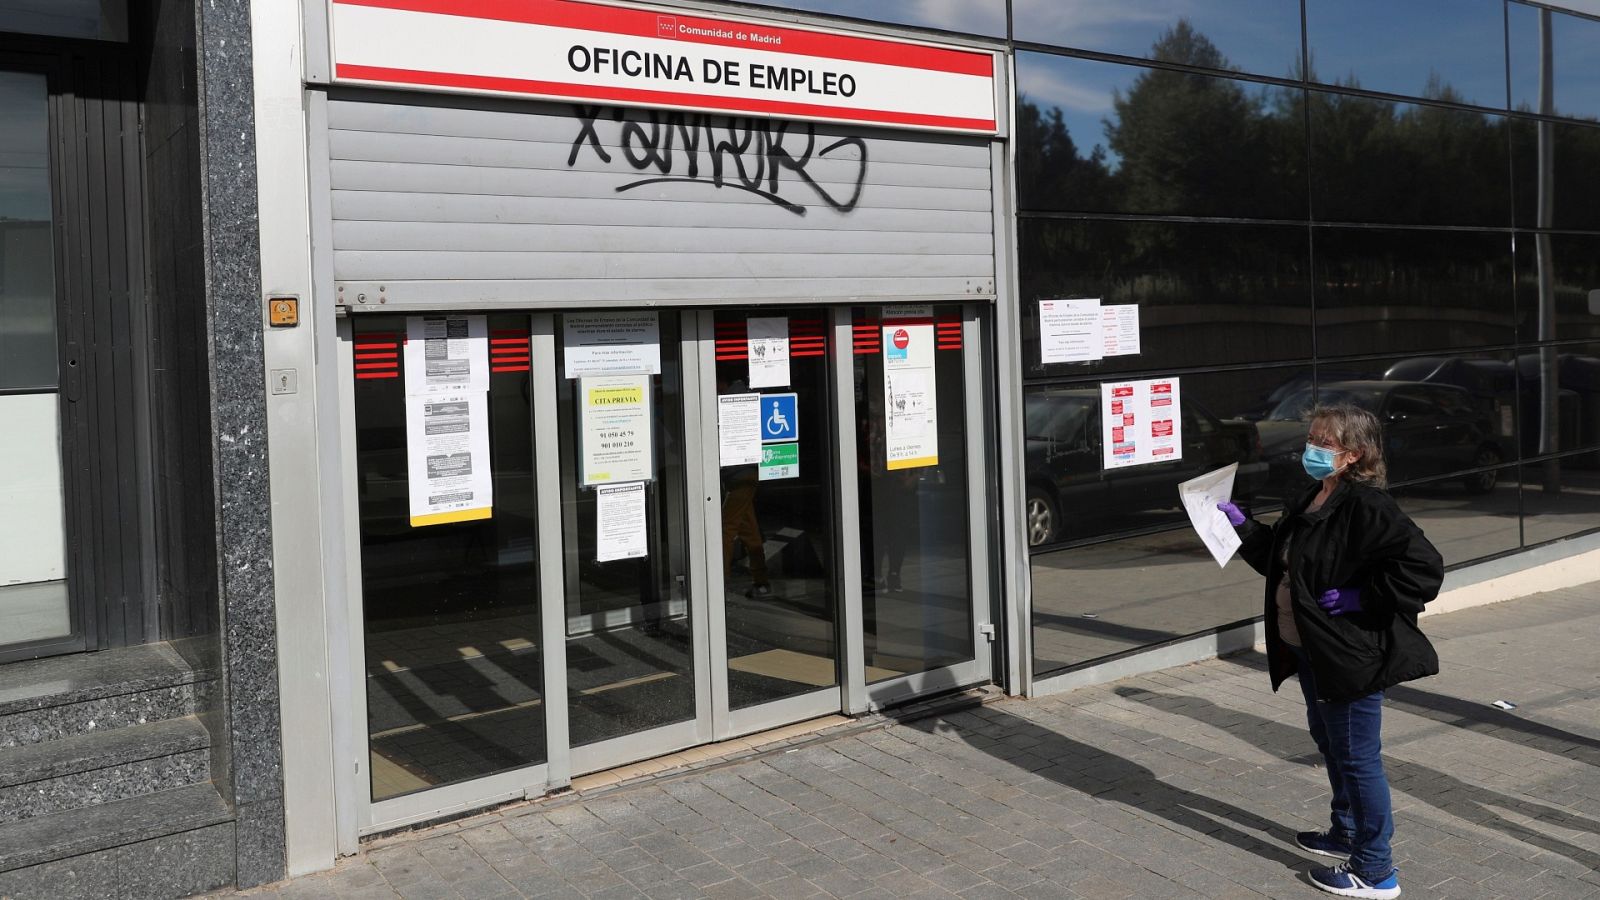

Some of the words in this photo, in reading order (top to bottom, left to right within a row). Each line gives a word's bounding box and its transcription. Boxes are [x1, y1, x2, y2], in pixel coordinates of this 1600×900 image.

[679, 24, 733, 39] Comunidad
[736, 31, 747, 41] de
[750, 33, 781, 45] Madrid
[567, 45, 694, 83] OFICINA
[702, 58, 741, 87] DE
[749, 63, 857, 98] EMPLEO
